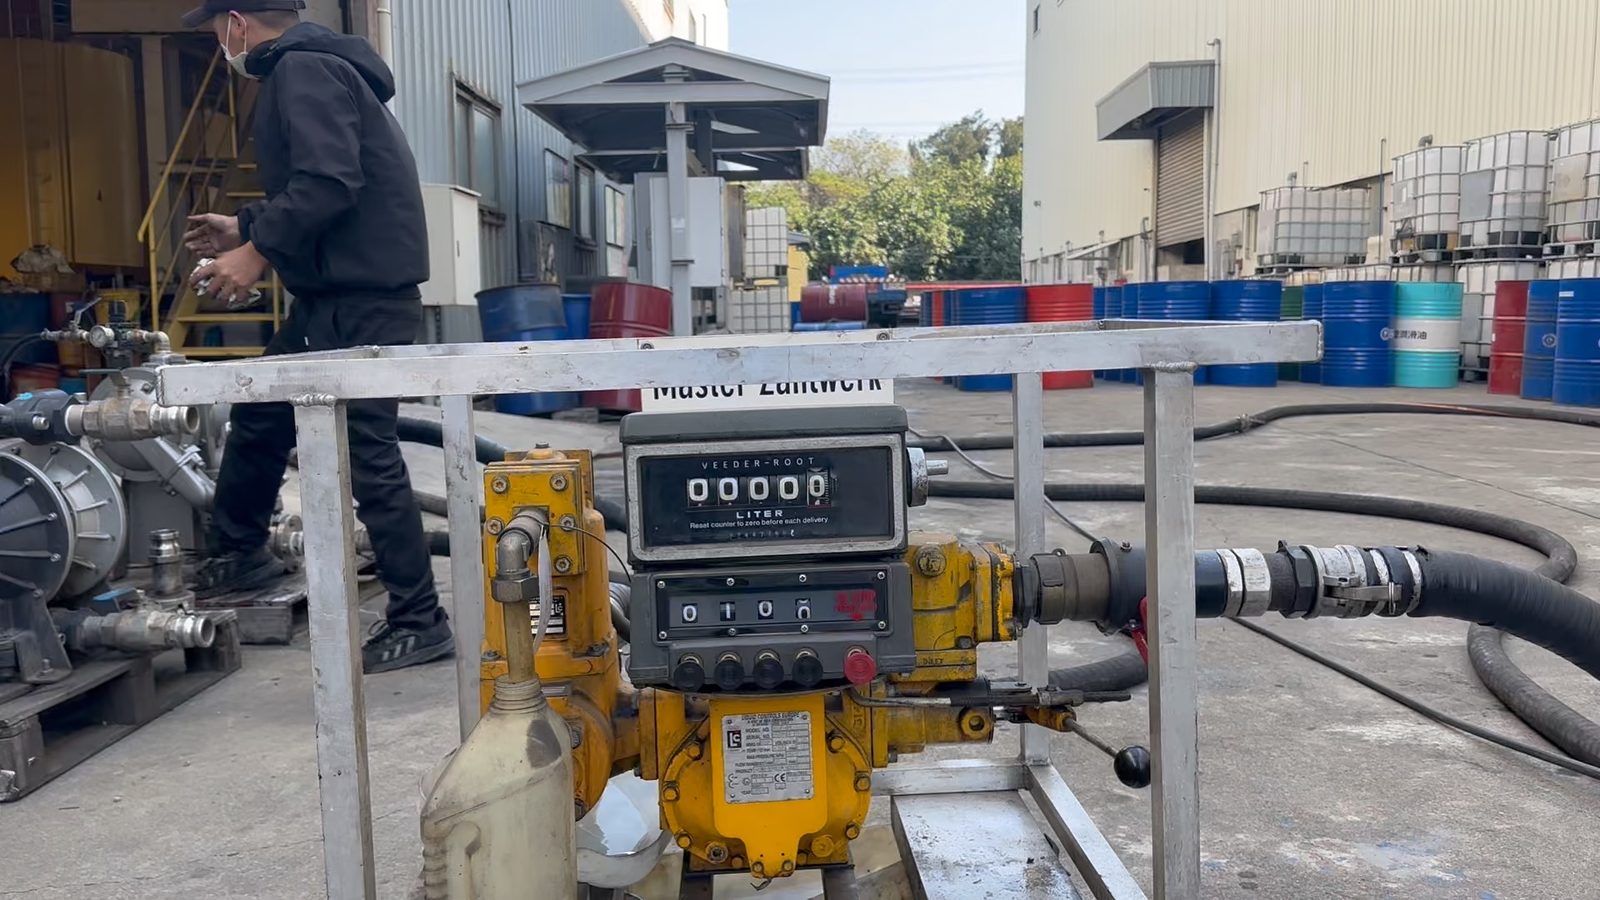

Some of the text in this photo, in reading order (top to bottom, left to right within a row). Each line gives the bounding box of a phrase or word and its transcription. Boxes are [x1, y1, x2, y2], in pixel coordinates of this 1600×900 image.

[702, 457, 814, 470] VEEDER-ROOT
[736, 509, 784, 519] LITER
[689, 522, 710, 530] Reset
[784, 517, 801, 525] each
[802, 516, 829, 525] delivery
